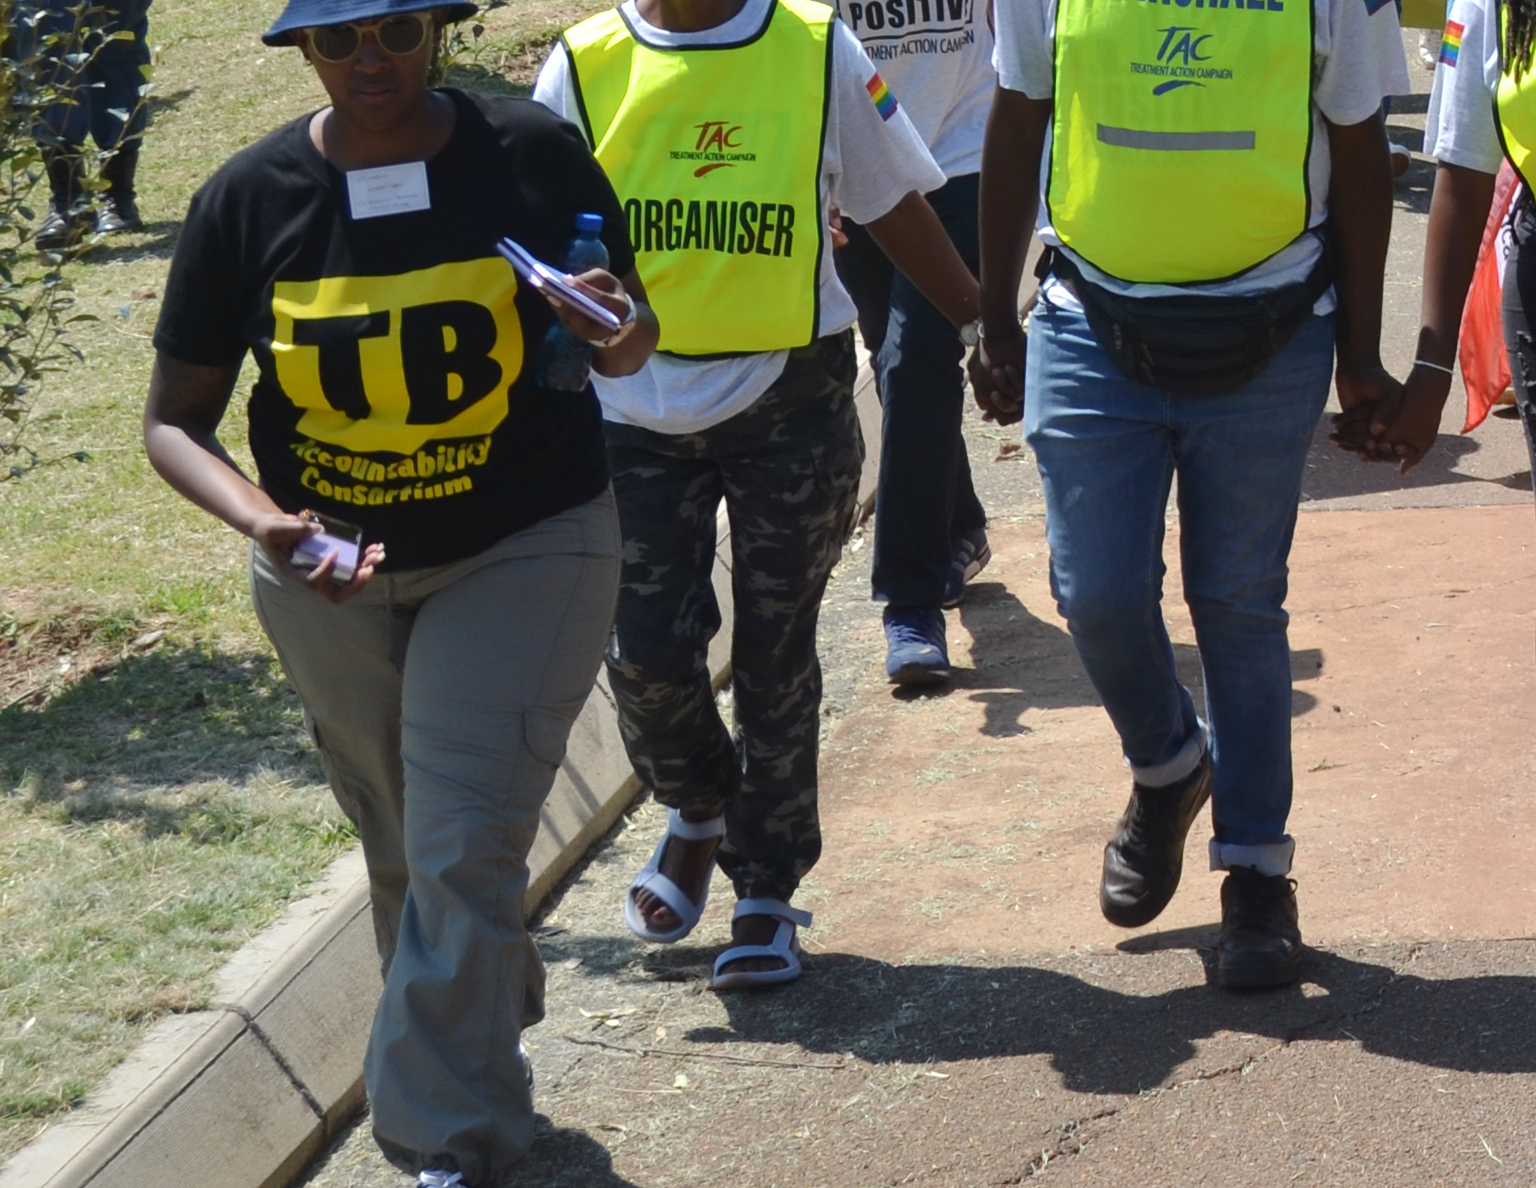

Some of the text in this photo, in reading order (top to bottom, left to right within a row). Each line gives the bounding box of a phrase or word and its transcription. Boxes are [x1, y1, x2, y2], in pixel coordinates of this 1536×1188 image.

[900, 38, 938, 56] ACTION
[1157, 26, 1213, 66] TAC
[1129, 62, 1233, 81] TREATMENT ACTION CAMPAIGN
[694, 121, 743, 153] TAC
[669, 151, 756, 162] TREATMENT ACTION CAMPAIGN
[624, 197, 795, 258] ORGANISER
[292, 299, 503, 426] TB
[290, 436, 492, 482] Accountability
[301, 469, 473, 506] Consortium
